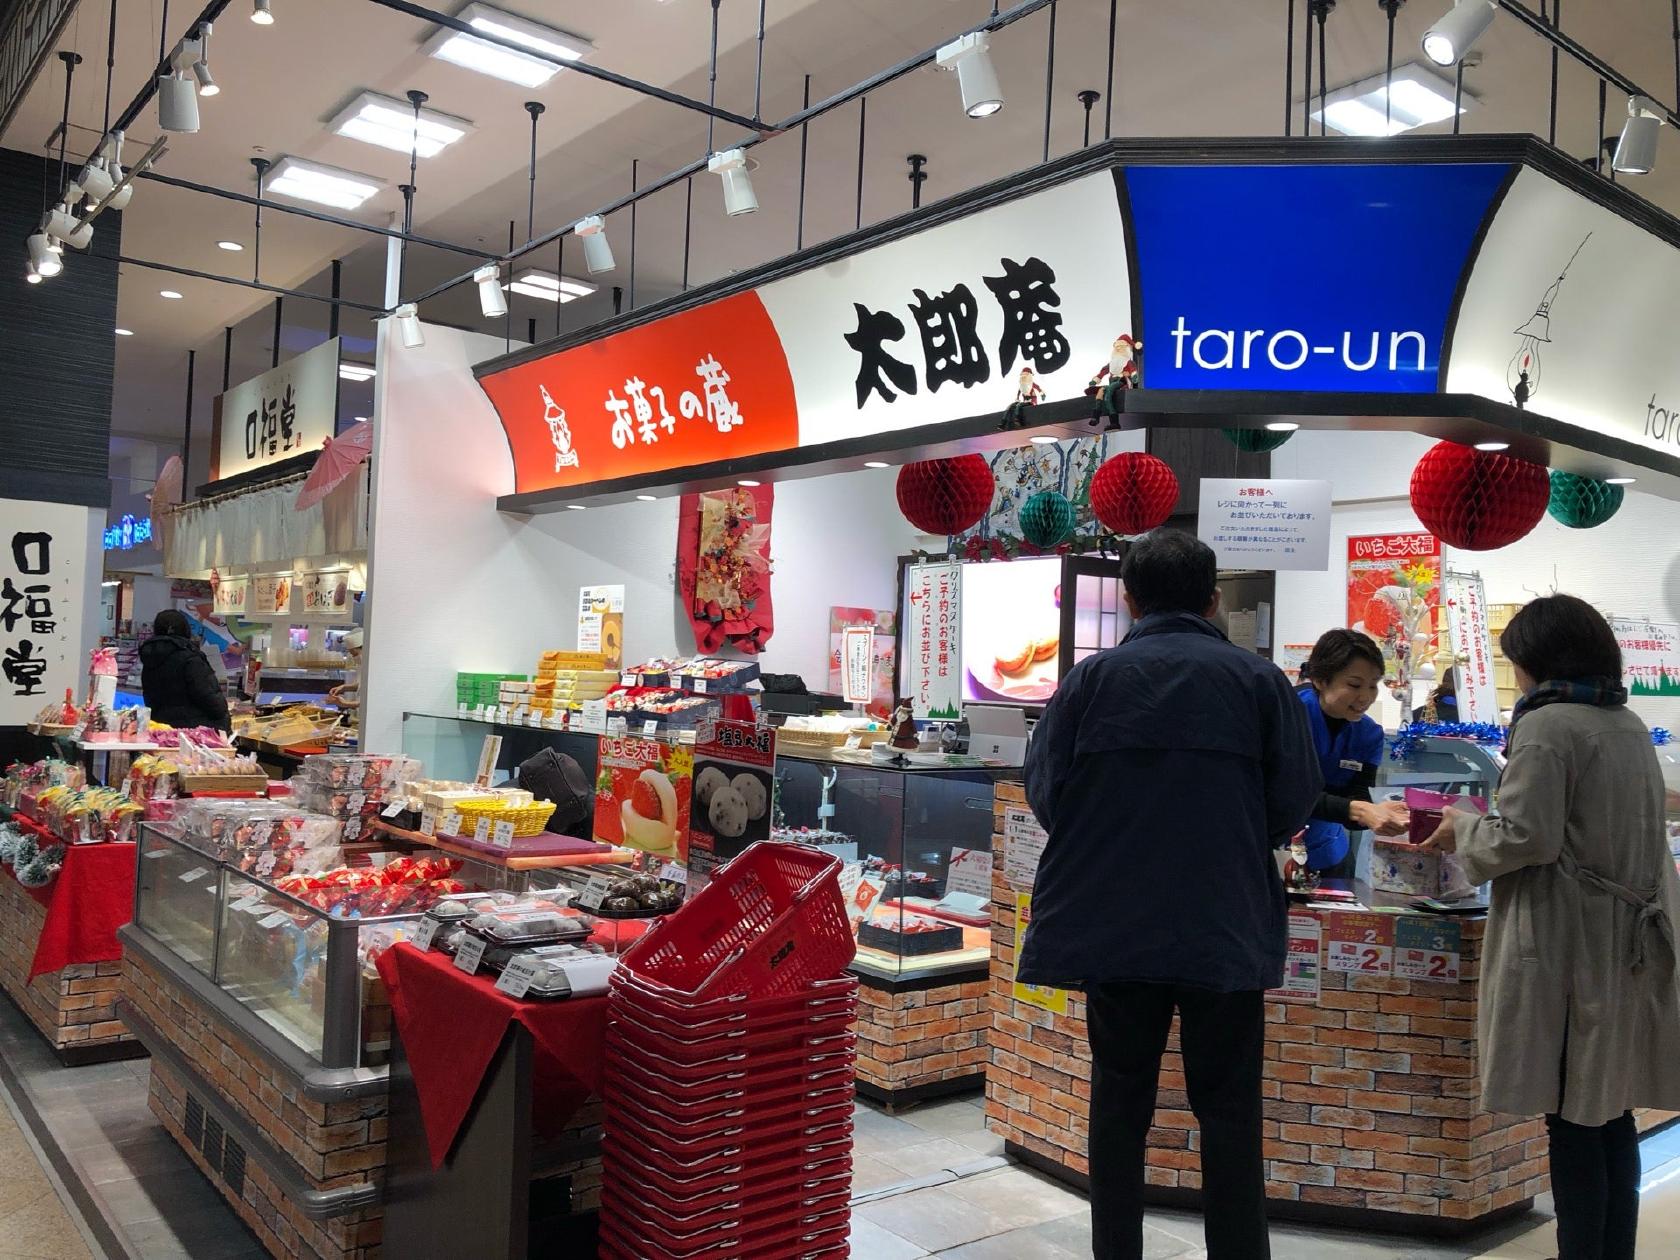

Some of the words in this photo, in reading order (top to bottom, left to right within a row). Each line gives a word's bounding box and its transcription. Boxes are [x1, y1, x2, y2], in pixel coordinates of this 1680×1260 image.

[843, 256, 1071, 409] 太郎庵
[1170, 316, 1426, 372] taro-un
[245, 383, 295, 460] 口福堂
[604, 353, 743, 450] お菓子の蔵
[1644, 392, 1680, 447] tar
[1238, 488, 1274, 497] お客様へ
[1355, 534, 1435, 557] いちご大福
[0, 530, 58, 697] 口福堂
[920, 574, 932, 711] こちらにお並び下さい。
[938, 572, 949, 678] ご予約のお客様は
[949, 570, 959, 656] クリスマスケーキ
[600, 737, 661, 763] いちご大福
[718, 725, 770, 754] 塩豆大福
